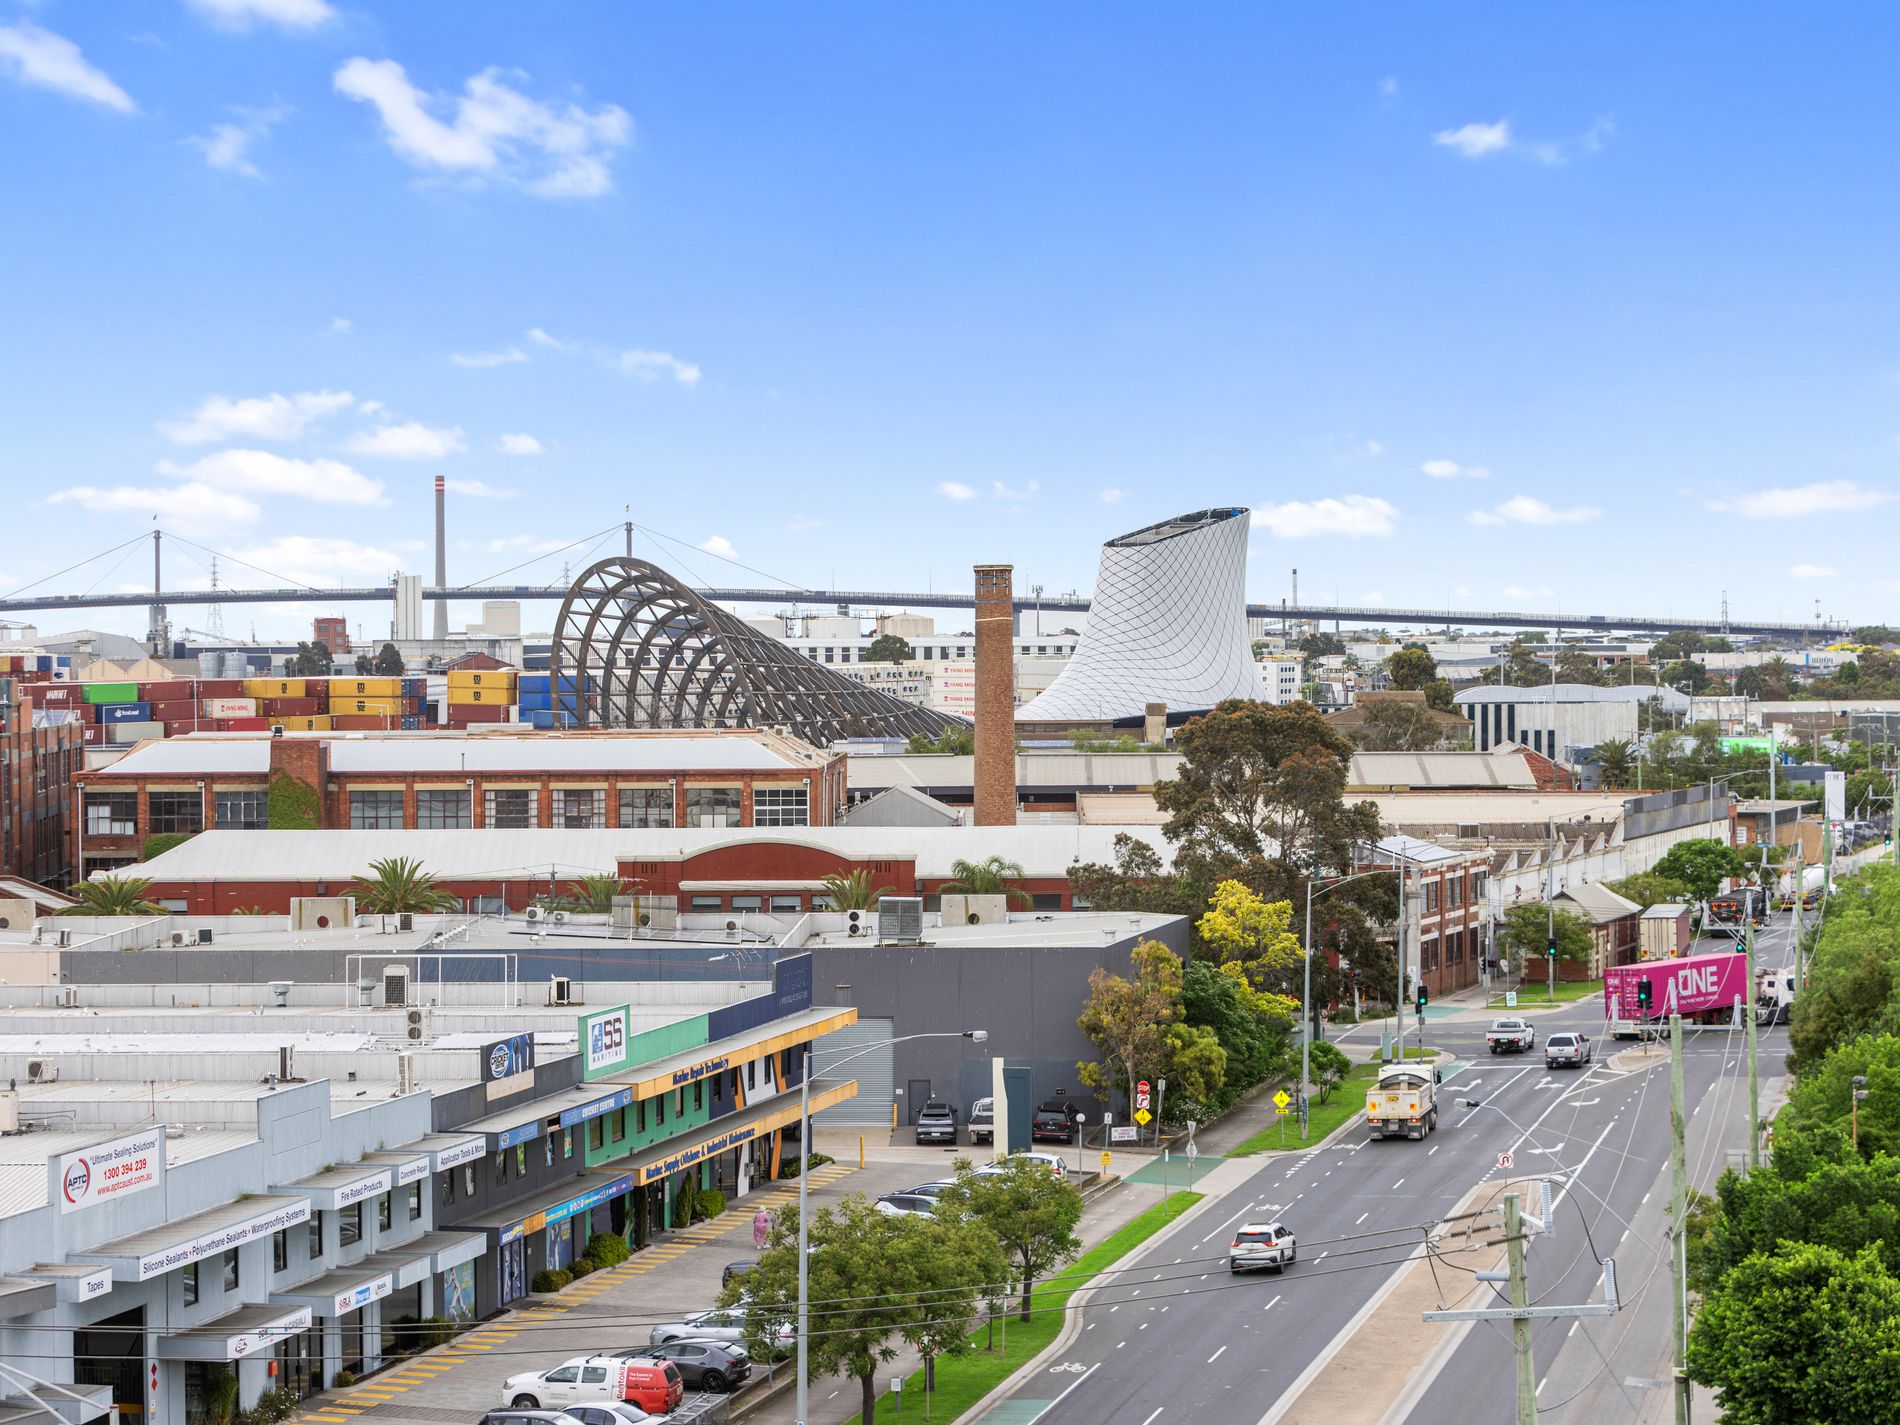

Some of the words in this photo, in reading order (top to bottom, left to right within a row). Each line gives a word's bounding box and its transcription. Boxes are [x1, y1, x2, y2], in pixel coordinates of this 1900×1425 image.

[1678, 965, 1719, 997] ONE
[592, 1048, 622, 1063] MARITIME
[672, 1070, 690, 1086] Marine
[690, 1064, 705, 1081] Repair
[582, 1103, 599, 1118] CRICKET
[600, 1097, 615, 1112] CENTRE
[113, 1146, 132, 1160] Sealing
[440, 1154, 460, 1167] Applicator
[460, 1149, 471, 1160] Tools
[474, 1143, 485, 1153] More
[646, 1164, 663, 1179] Marine
[663, 1154, 680, 1173] Supply
[701, 1145, 706, 1157] &
[706, 1135, 728, 1155] Industrial
[728, 1127, 755, 1146] Maintenance
[103, 1166, 120, 1180] 1300
[121, 1161, 133, 1175] 394
[135, 1158, 147, 1172] 239
[400, 1168, 416, 1180] Concrete
[416, 1164, 428, 1175] Repair
[68, 1174, 88, 1188] APTC
[341, 1191, 350, 1202] Fire
[350, 1186, 363, 1199] Rated
[363, 1180, 383, 1195] Products
[143, 1258, 165, 1274] Silicone
[165, 1249, 189, 1267] Sealants
[192, 1237, 226, 1259] Polyurethane
[226, 1228, 248, 1245] Sealants
[251, 1214, 286, 1237] Waterproofing
[286, 1208, 306, 1224] Systems
[87, 1279, 105, 1293] Tapes
[617, 1366, 626, 1399] Rentokil
